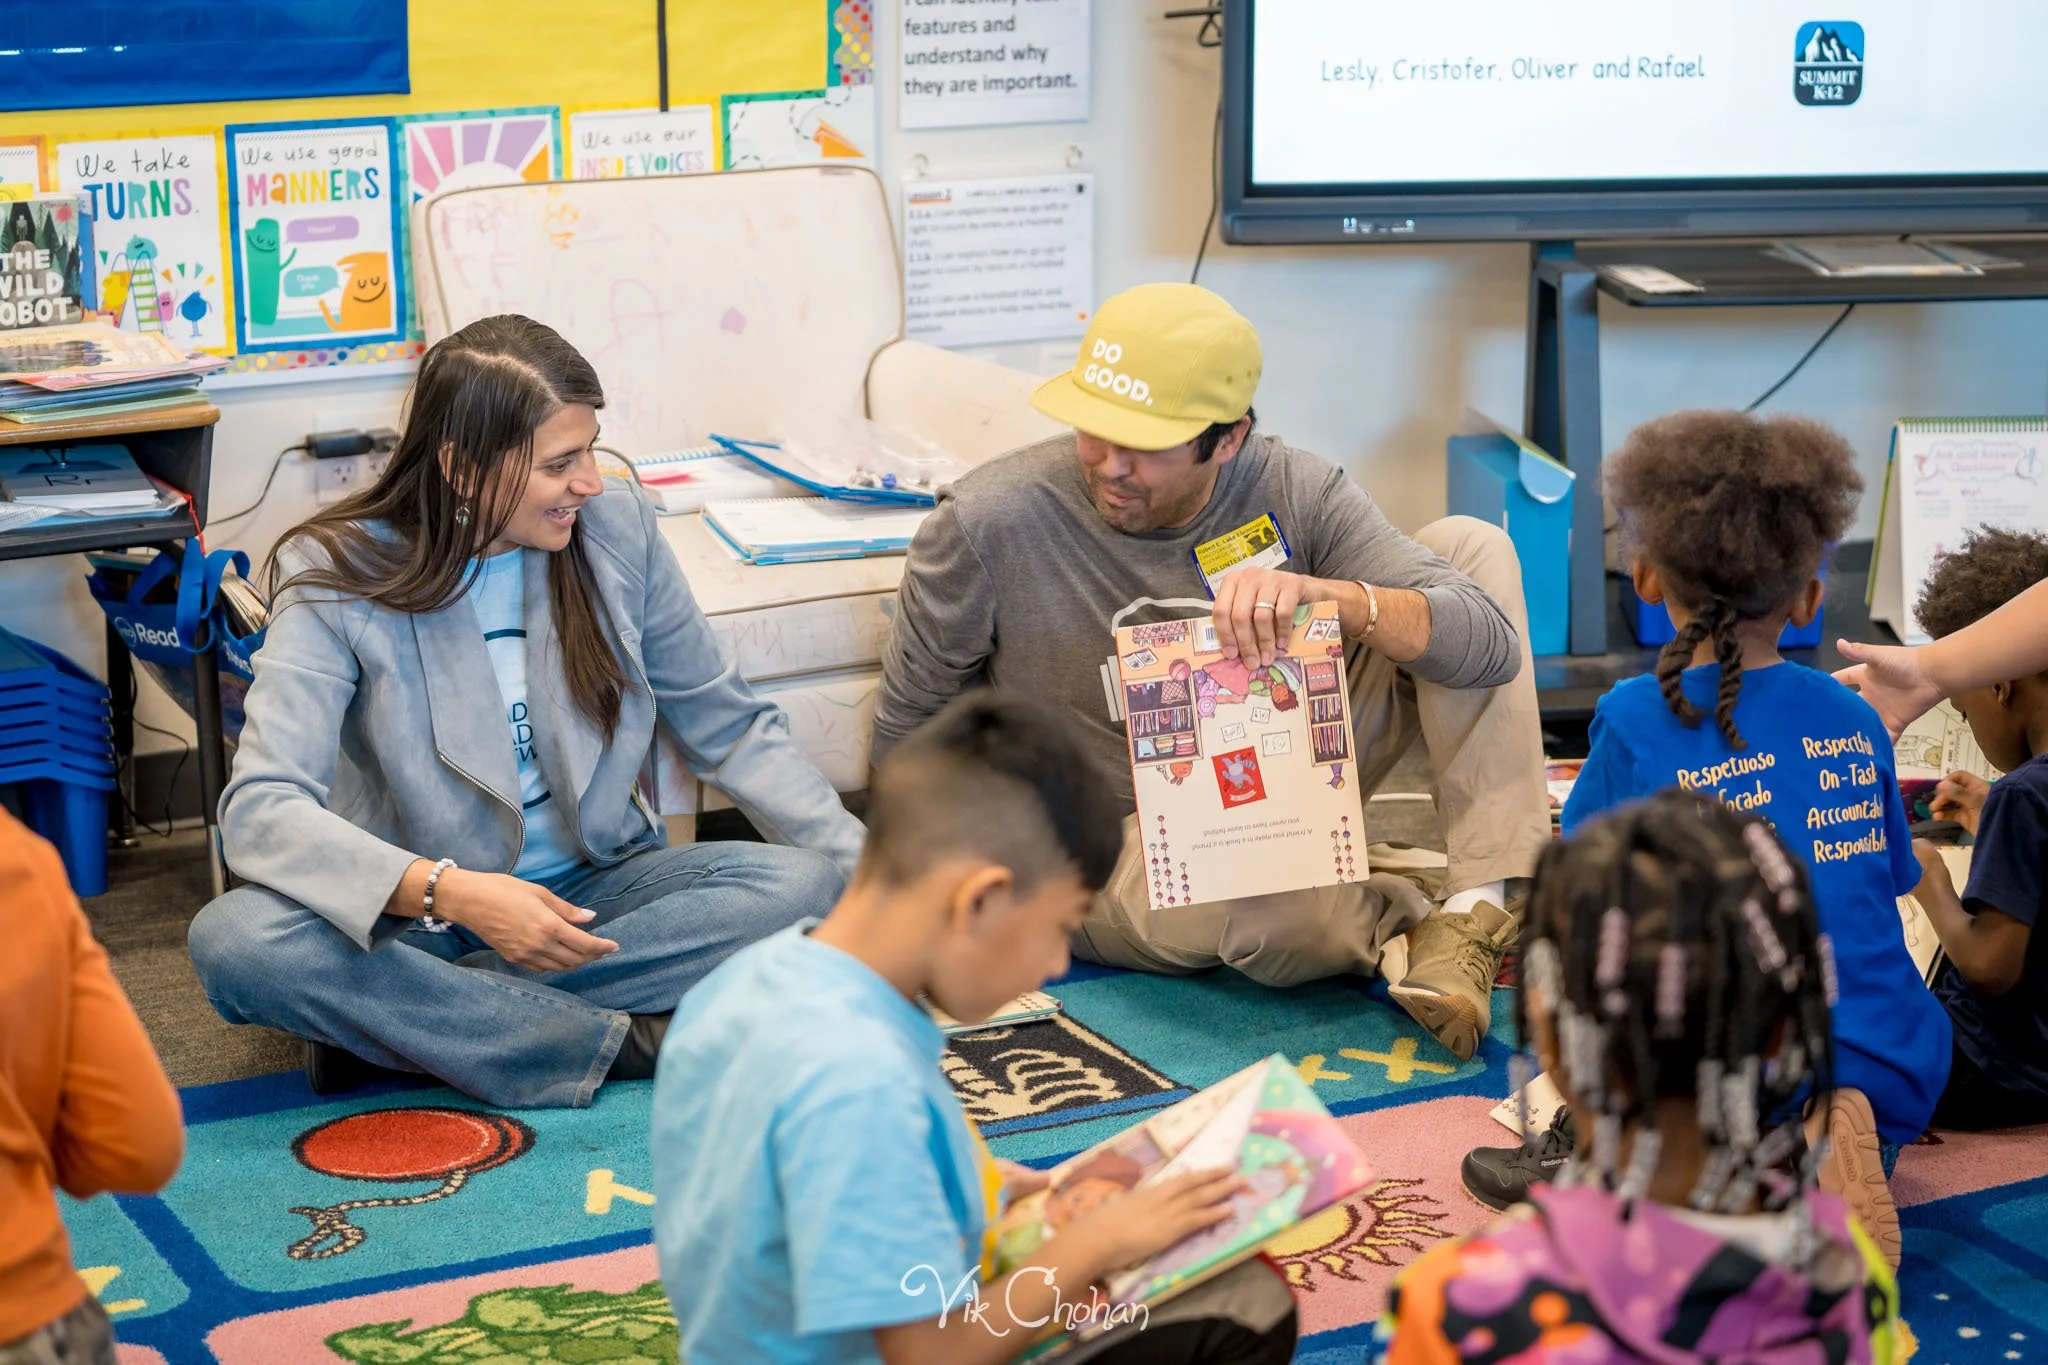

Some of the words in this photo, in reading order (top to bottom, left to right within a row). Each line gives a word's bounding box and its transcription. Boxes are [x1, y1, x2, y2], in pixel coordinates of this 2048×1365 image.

[905, 18, 977, 36] features
[983, 15, 1017, 33] and
[904, 44, 1006, 65] understand
[1010, 44, 1049, 64] why
[1392, 57, 1502, 82] Cristofer,
[1511, 57, 1578, 81] Oliver
[1592, 55, 1631, 79] and
[1638, 54, 1705, 79] Rafael
[1798, 70, 1858, 86] SUMMIT
[904, 78, 944, 96] they
[949, 78, 978, 93] are
[982, 73, 1078, 94] important.
[582, 131, 612, 149] We
[622, 132, 653, 145] use
[663, 129, 698, 142] our
[76, 153, 116, 178] We
[132, 147, 191, 174] take
[242, 146, 274, 166] We
[285, 148, 317, 162] use
[328, 139, 378, 165] good
[0, 249, 50, 272] THE
[0, 296, 74, 327] OBOT
[1091, 337, 1123, 365] DO
[1084, 363, 1153, 407] GOOD.
[1205, 553, 1248, 576] VOLUNTEER
[134, 622, 181, 648] Read
[1676, 752, 1776, 792] Respetuoso
[1819, 760, 1878, 791] On-Task
